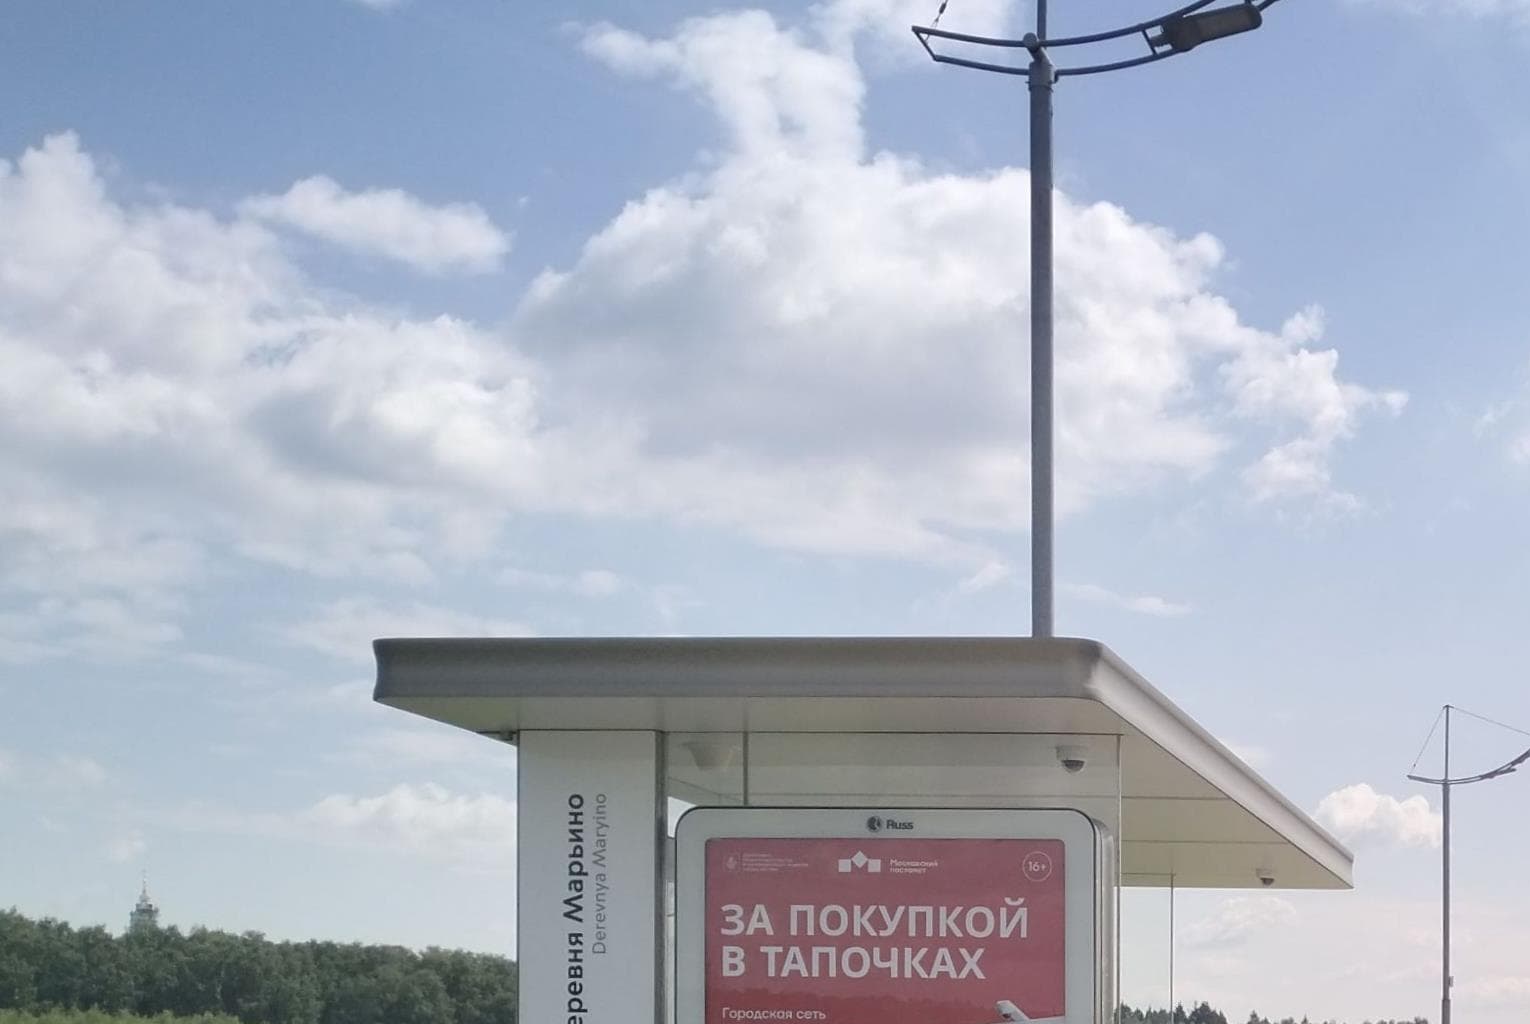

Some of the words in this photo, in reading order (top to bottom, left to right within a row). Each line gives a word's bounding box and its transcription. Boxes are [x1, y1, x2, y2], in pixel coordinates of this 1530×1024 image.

[592, 793, 610, 868] Maryino
[886, 819, 914, 830] Russ
[562, 794, 589, 923] Марьино
[890, 859, 938, 868] Московский
[1028, 861, 1046, 871] 16+
[592, 873, 609, 954] Derevnya
[720, 903, 775, 936] ЗА
[789, 897, 1028, 938] ПОКУПКОЙ
[721, 946, 746, 977] В
[759, 946, 986, 979] ТАПОЧКАХ
[722, 1007, 793, 1021] Городская
[796, 1010, 826, 1020] сеть
